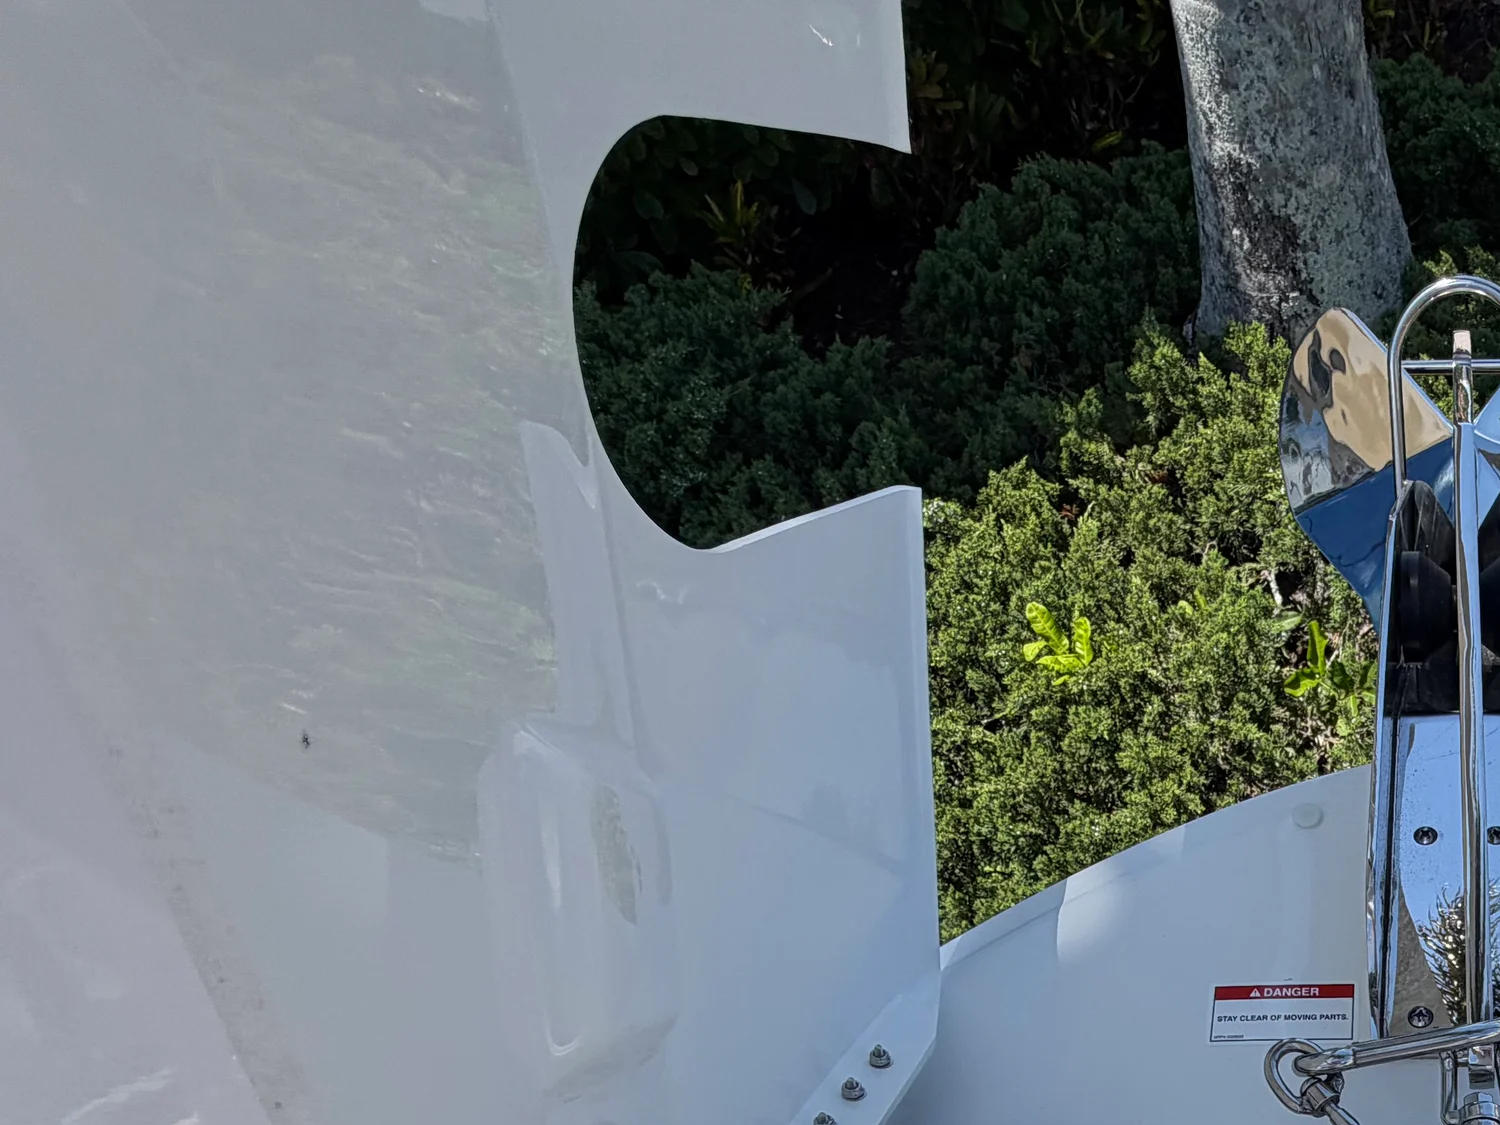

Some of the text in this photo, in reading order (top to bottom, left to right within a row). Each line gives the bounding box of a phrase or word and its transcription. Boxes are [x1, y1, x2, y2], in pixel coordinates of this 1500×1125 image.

[1263, 986, 1320, 997] DANGER
[1240, 1014, 1269, 1022] CLEAR
[1283, 1013, 1318, 1021] MOVING
[1319, 1013, 1349, 1021] PARTS.
